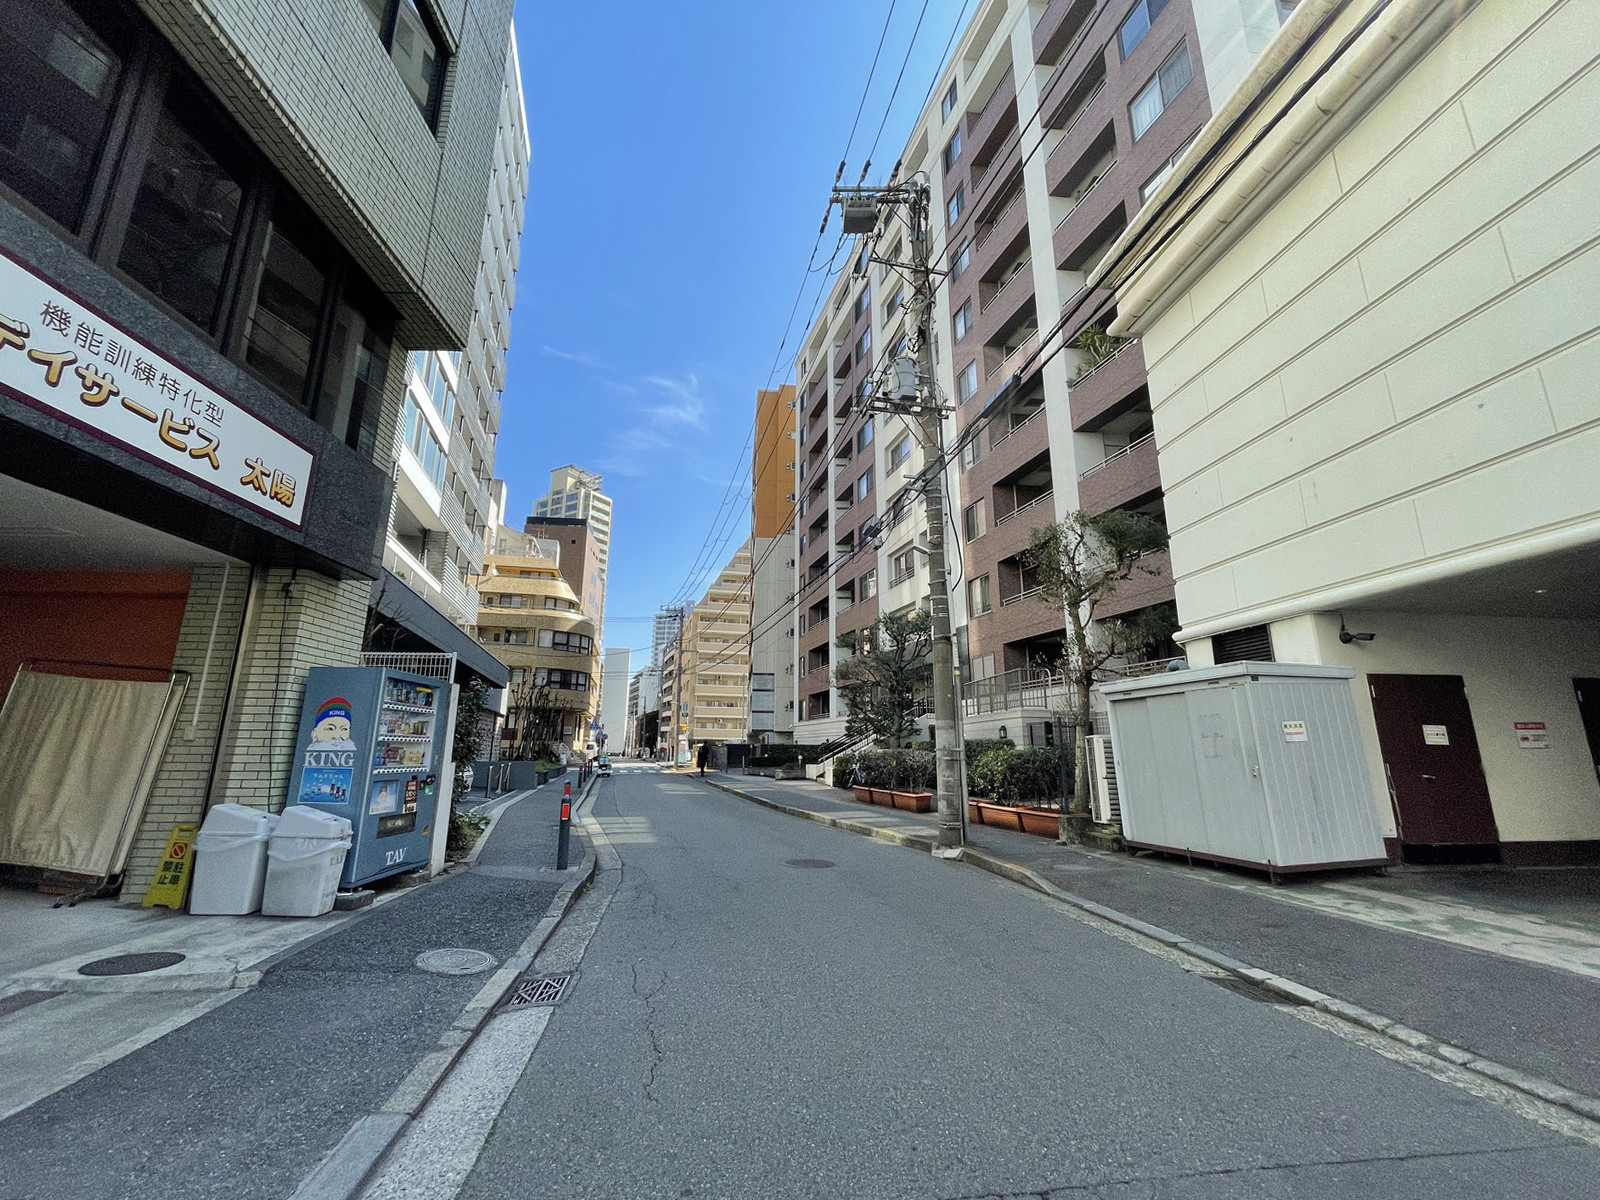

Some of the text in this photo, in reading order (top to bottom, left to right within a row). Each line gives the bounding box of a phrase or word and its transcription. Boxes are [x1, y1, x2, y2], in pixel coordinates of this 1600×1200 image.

[40, 299, 226, 428] 機能訓練特化型
[240, 457, 297, 508] 太陽
[302, 752, 356, 768] KING
